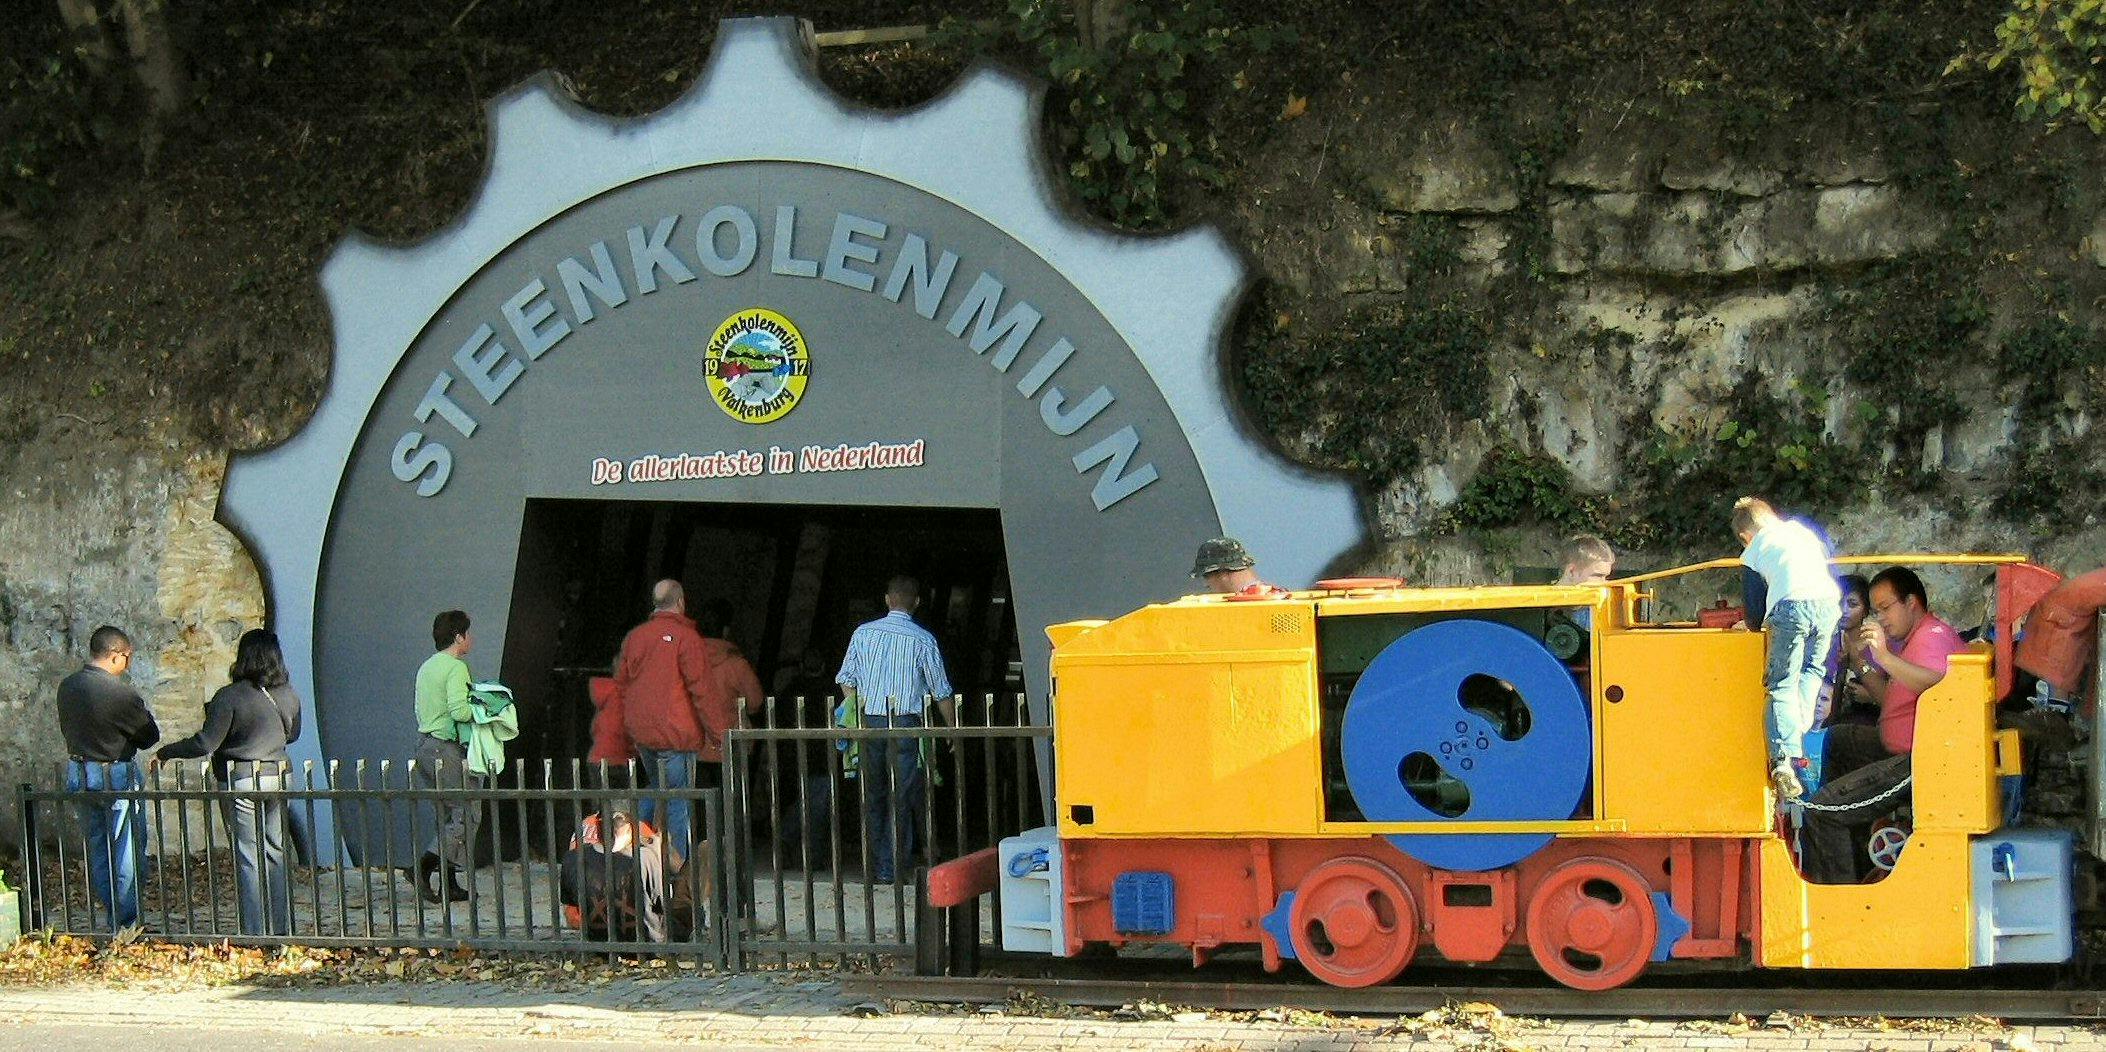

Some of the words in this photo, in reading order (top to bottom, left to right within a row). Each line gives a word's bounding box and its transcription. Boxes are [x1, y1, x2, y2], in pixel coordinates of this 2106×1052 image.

[708, 313, 798, 357] Steenkolenmijn
[390, 204, 1160, 512] STEENKOLENMIJN
[704, 359, 720, 377] 19
[793, 359, 807, 376] 17
[717, 386, 795, 419] Valkenburg
[591, 457, 623, 485] De
[628, 450, 764, 483] allerlaatste
[769, 446, 794, 475] in
[799, 439, 926, 473] Nederland
